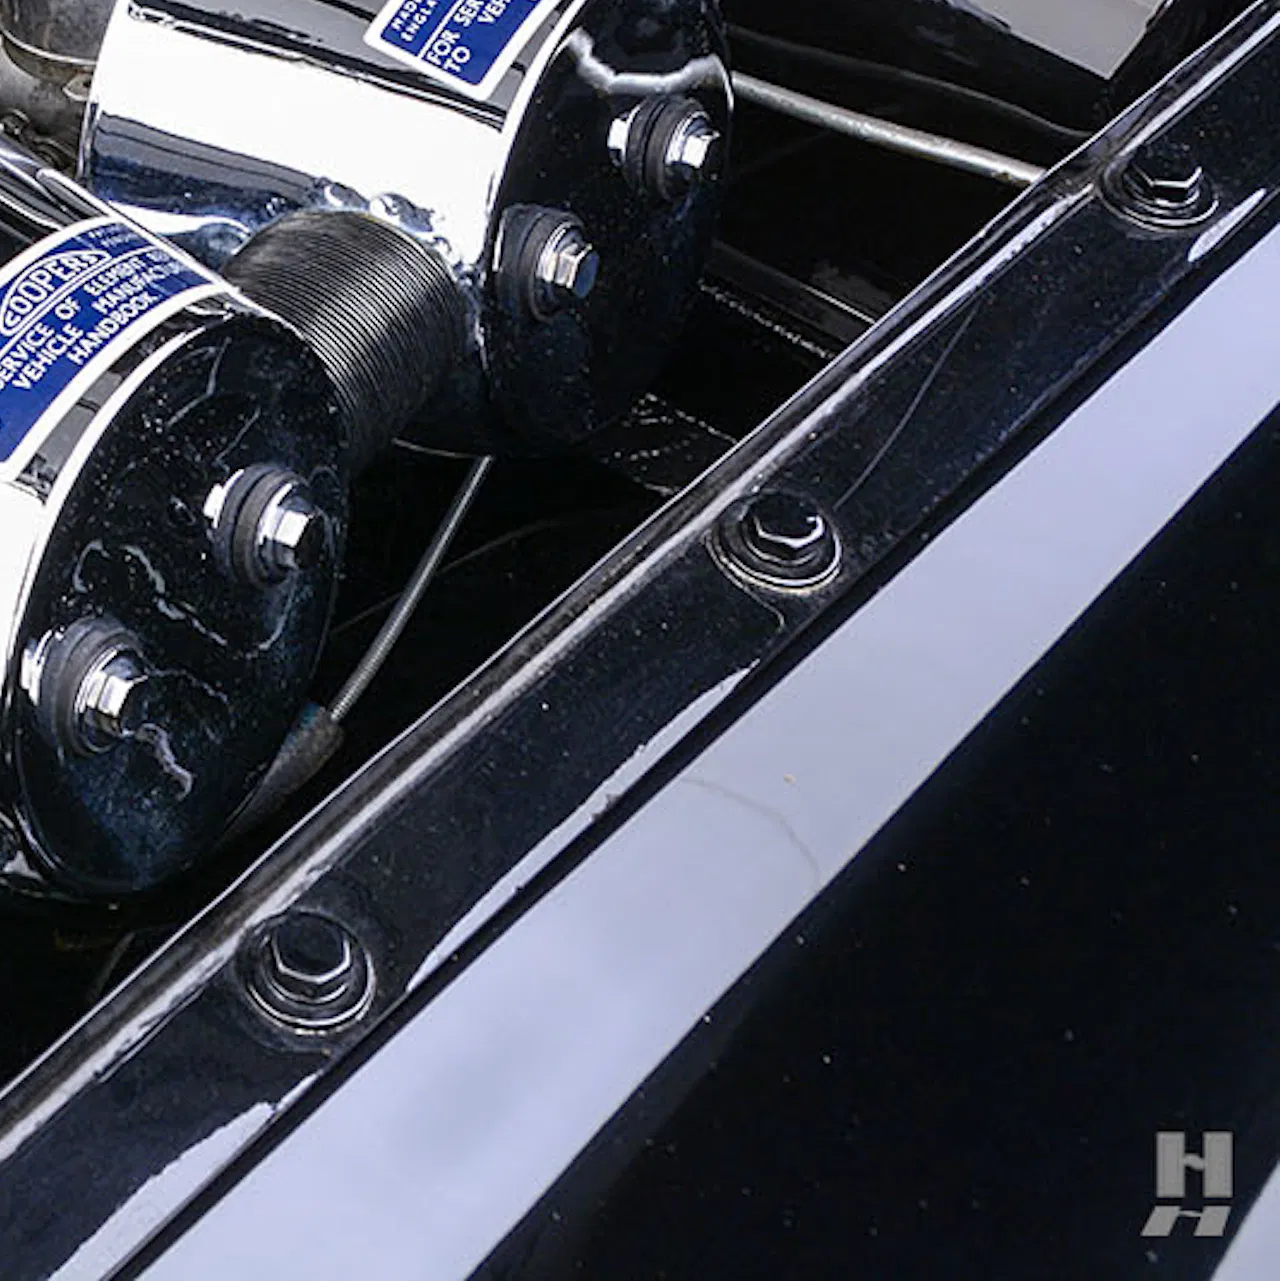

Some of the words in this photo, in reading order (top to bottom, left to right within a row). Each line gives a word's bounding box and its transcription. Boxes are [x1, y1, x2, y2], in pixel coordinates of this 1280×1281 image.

[426, 29, 460, 64] FOR
[444, 46, 470, 72] TO
[3, 252, 115, 328] COOPERS
[55, 296, 82, 321] OF
[13, 324, 84, 390] VEHICLE
